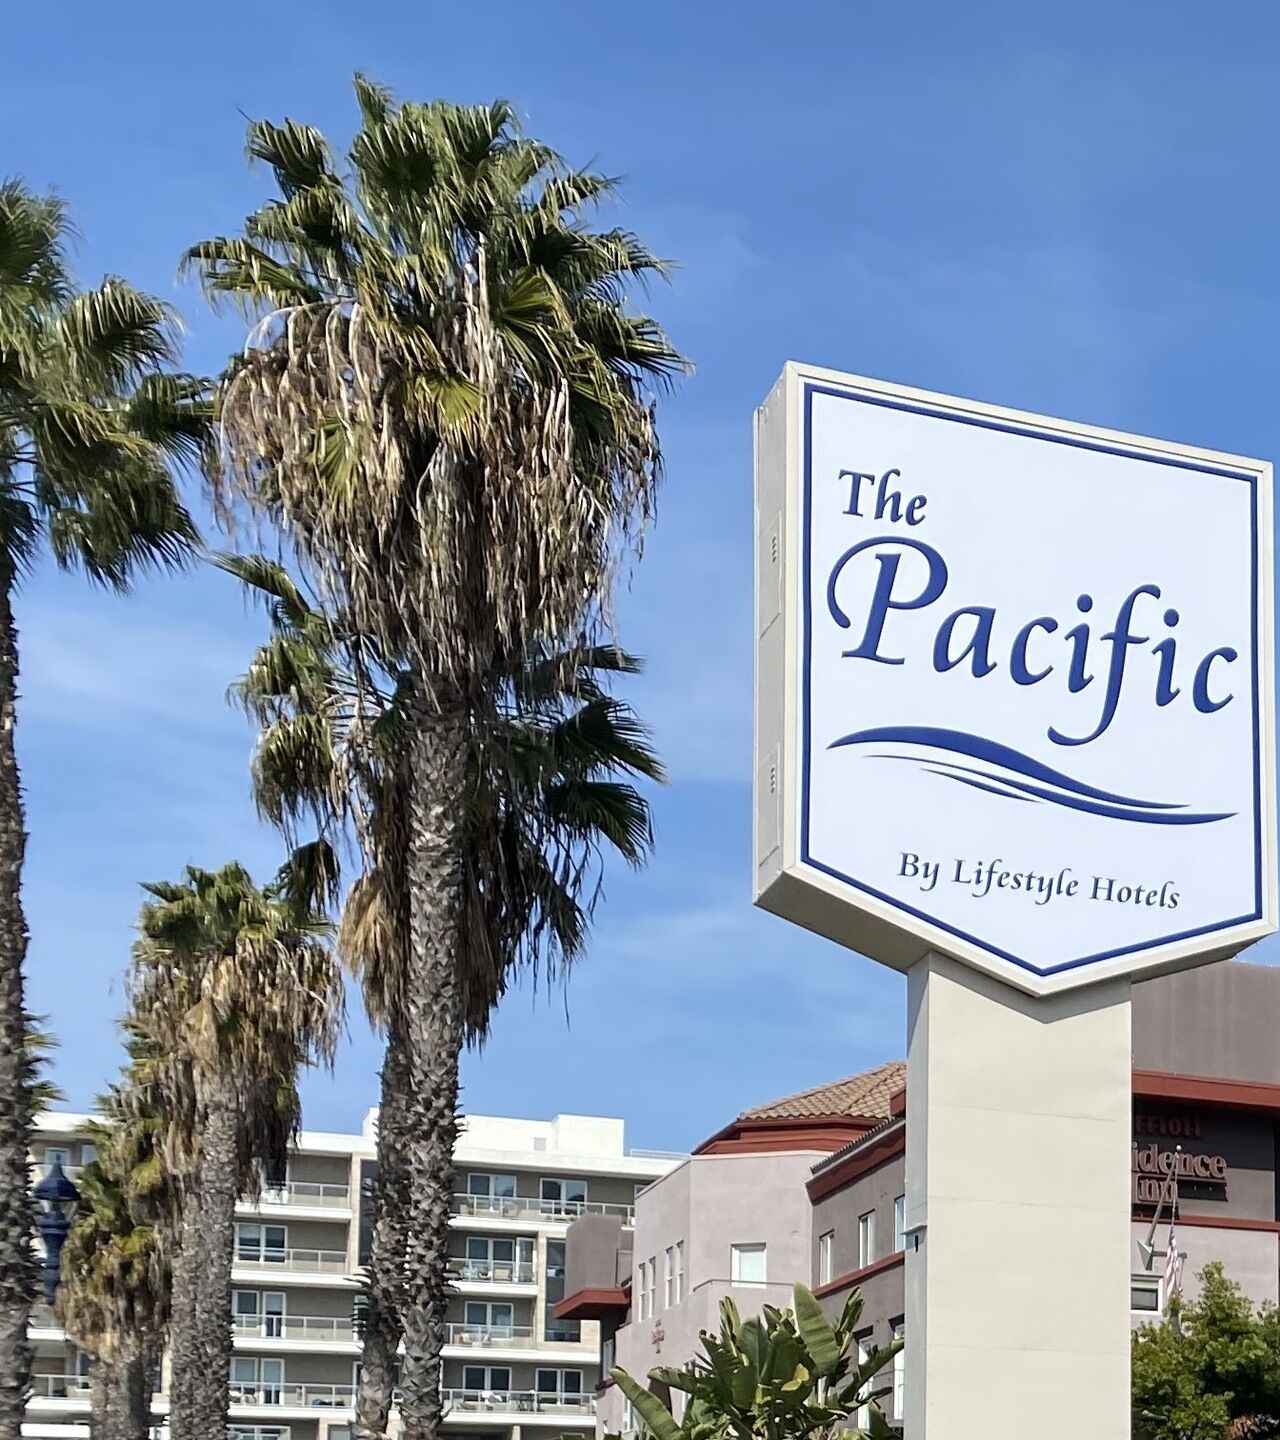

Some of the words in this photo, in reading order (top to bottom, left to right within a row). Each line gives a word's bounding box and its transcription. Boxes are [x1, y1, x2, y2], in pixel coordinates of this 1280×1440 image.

[838, 469, 928, 527] The
[826, 536, 1239, 746] Pacific
[897, 851, 940, 891] By
[951, 858, 1079, 906] Lifestyle
[1088, 875, 1180, 910] Hotels
[1131, 1141, 1227, 1178] idence
